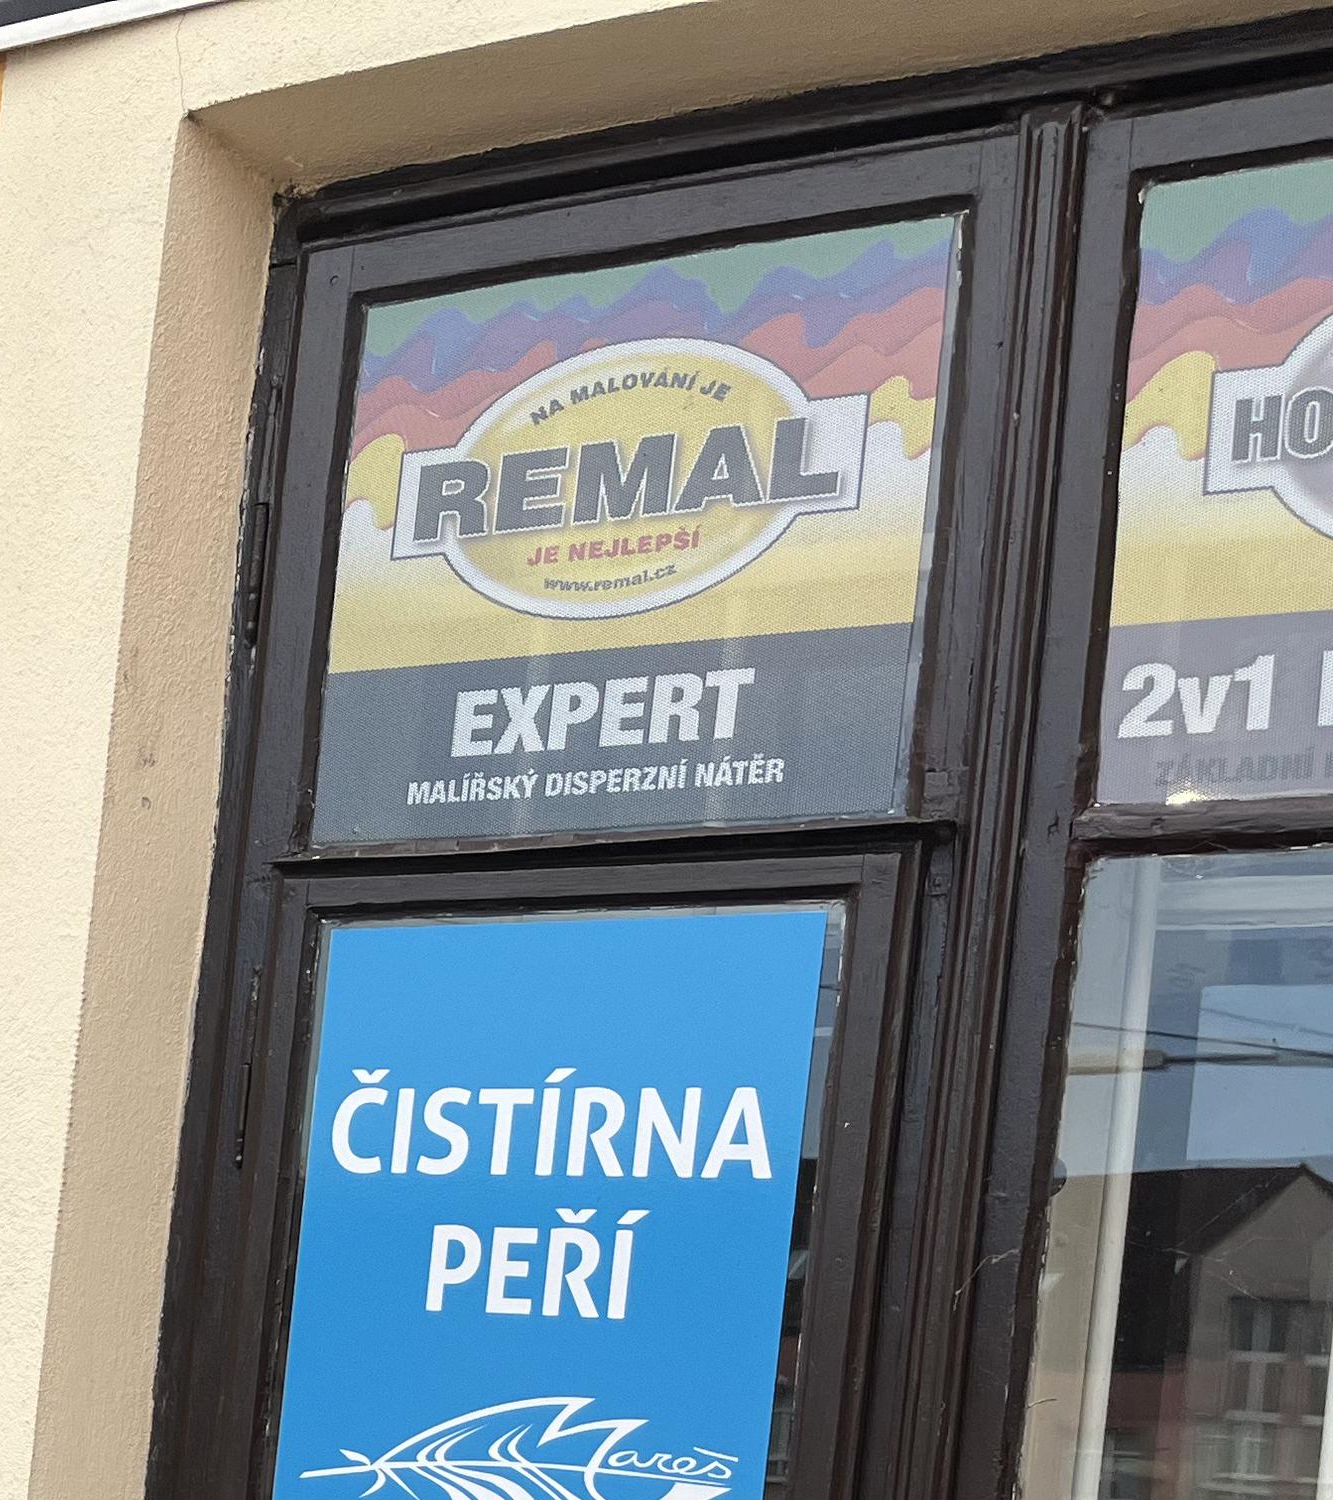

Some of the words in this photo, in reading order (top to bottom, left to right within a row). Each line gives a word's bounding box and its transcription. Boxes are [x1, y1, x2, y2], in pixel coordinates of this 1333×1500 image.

[530, 399, 564, 426] NA
[570, 366, 701, 405] MALOVÁNÍ
[700, 379, 732, 402] JE
[411, 417, 839, 544] REMAL
[526, 545, 561, 567] JE
[568, 524, 702, 562] NEJLEPŠÍ
[544, 564, 677, 592] www.remal.cz
[450, 667, 755, 759] EXPERT
[1117, 654, 1275, 739] 2v1
[406, 768, 539, 805] MALÍŘSKÝ
[544, 758, 688, 798] DISPERZNÍ
[694, 753, 785, 787] NÁTĚR
[332, 1068, 772, 1180] ČISTÍRNA
[425, 1209, 651, 1320] PEŘÍ
